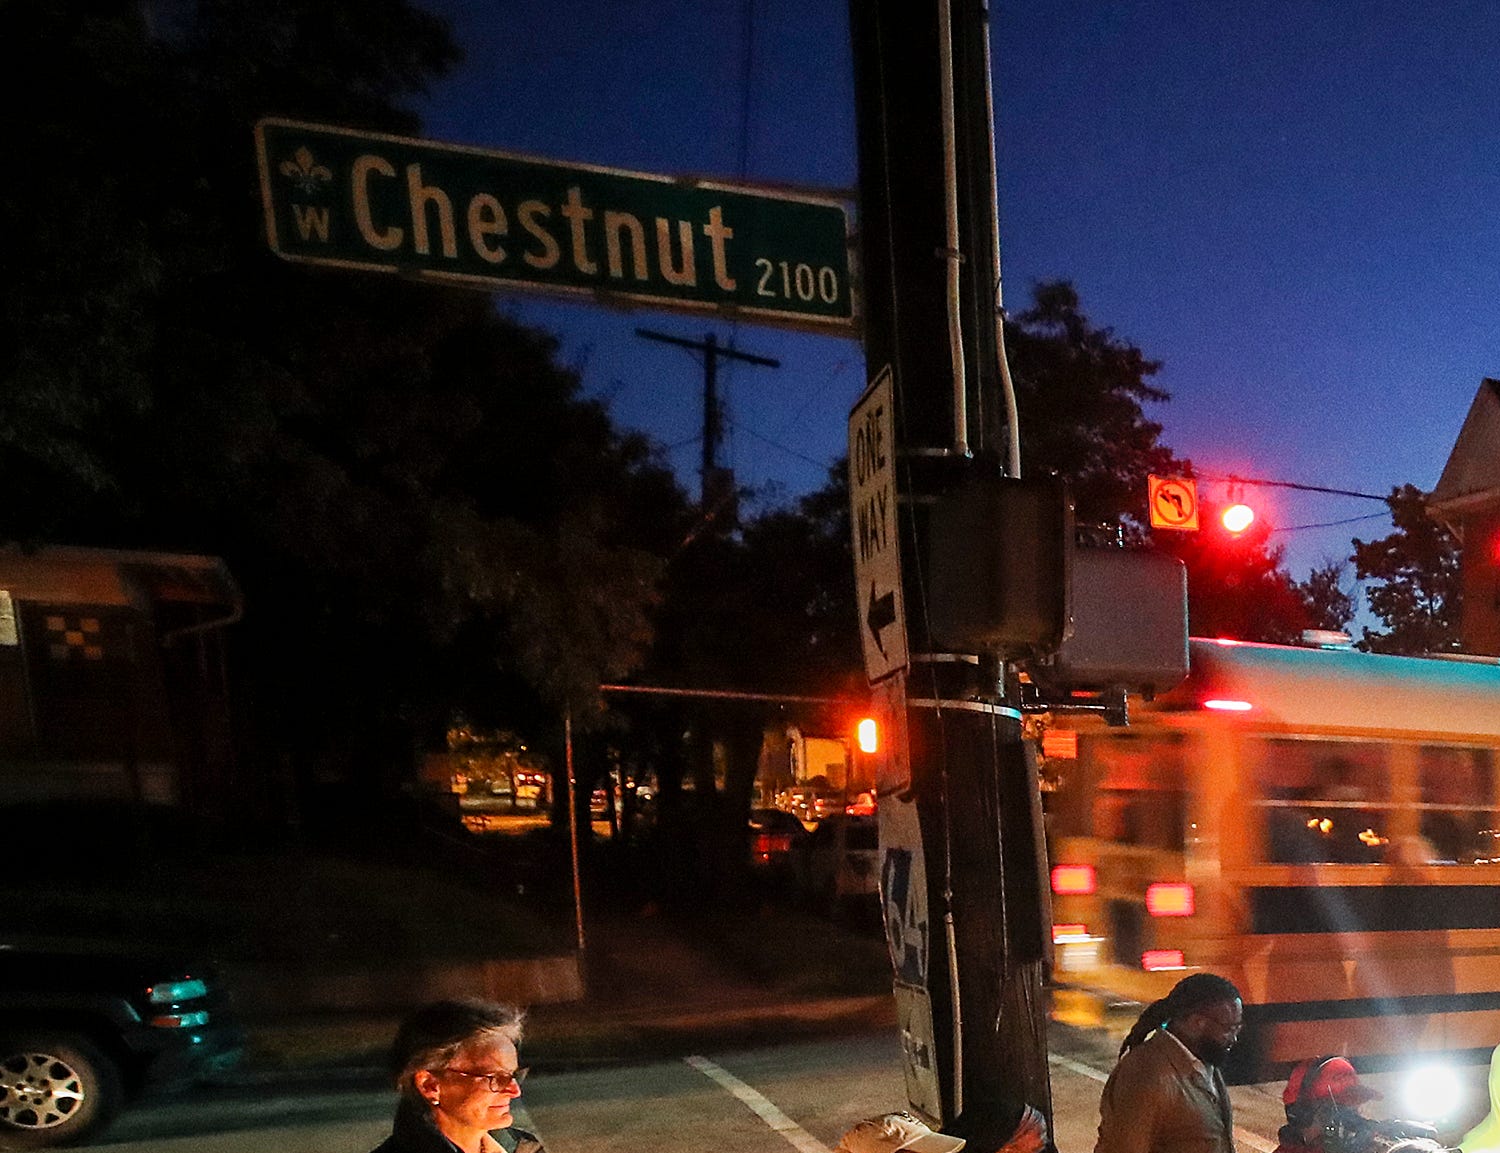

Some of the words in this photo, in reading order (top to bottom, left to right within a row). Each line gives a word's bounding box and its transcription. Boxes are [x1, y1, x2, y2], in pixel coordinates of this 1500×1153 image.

[294, 203, 330, 243] W
[351, 154, 738, 292] Chestnut
[754, 257, 839, 305] 2100
[855, 403, 886, 488] ONE
[857, 484, 888, 565] WAY
